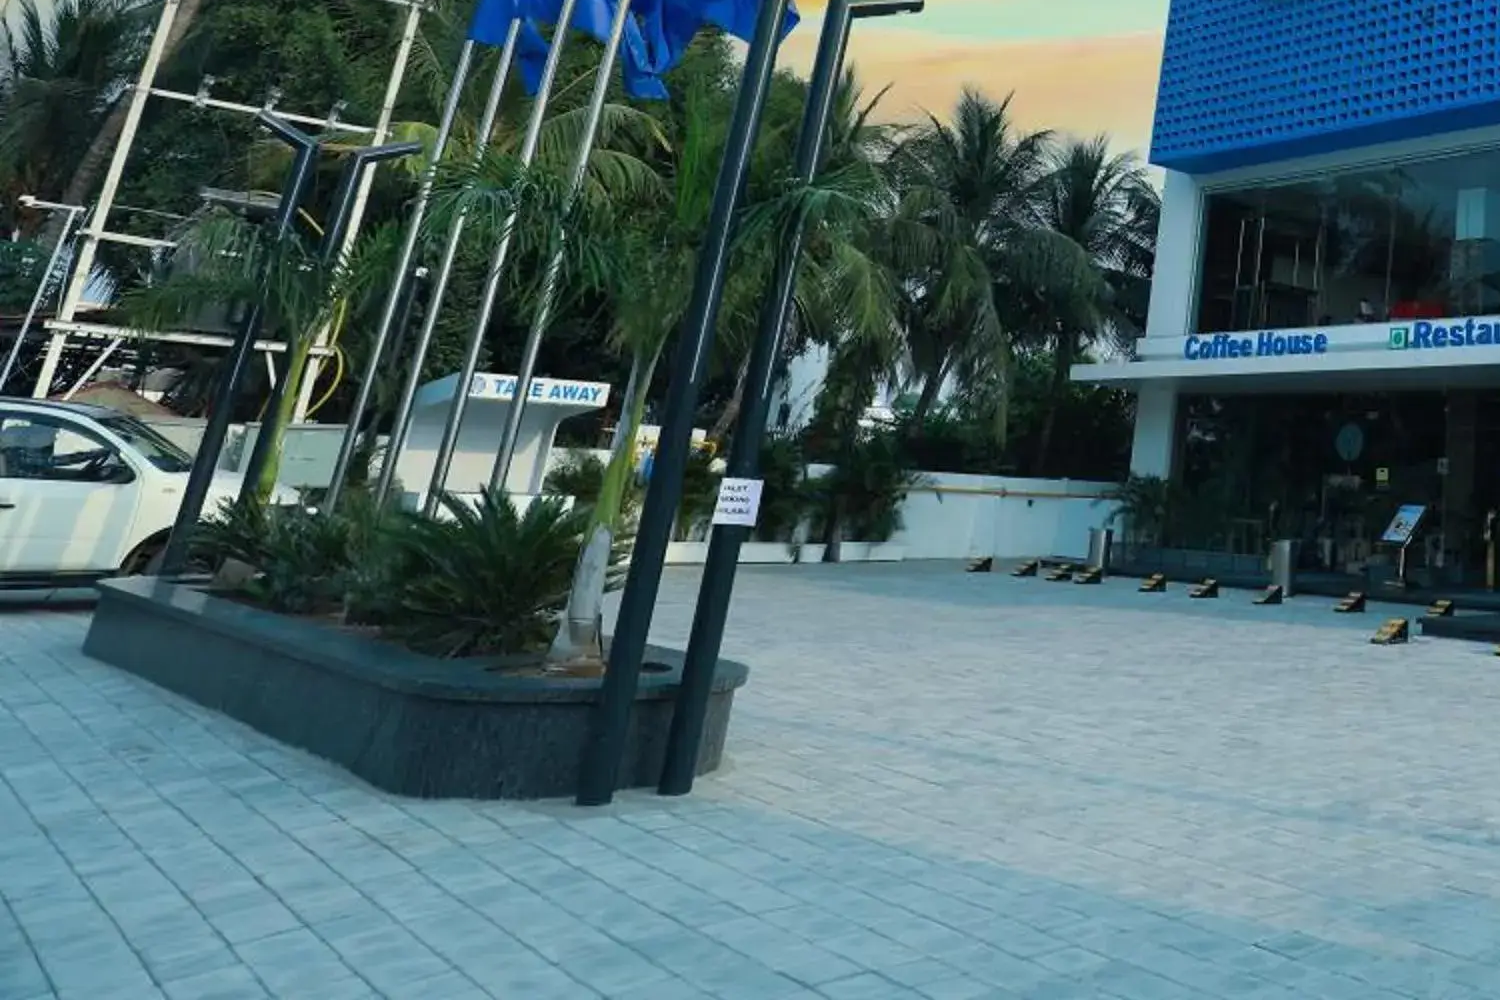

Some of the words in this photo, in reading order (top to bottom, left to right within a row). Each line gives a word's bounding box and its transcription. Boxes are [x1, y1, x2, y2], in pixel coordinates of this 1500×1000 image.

[1184, 334, 1253, 360] Coffee
[1256, 332, 1328, 357] House
[494, 379, 544, 398] TAE
[548, 384, 602, 401] AWAY
